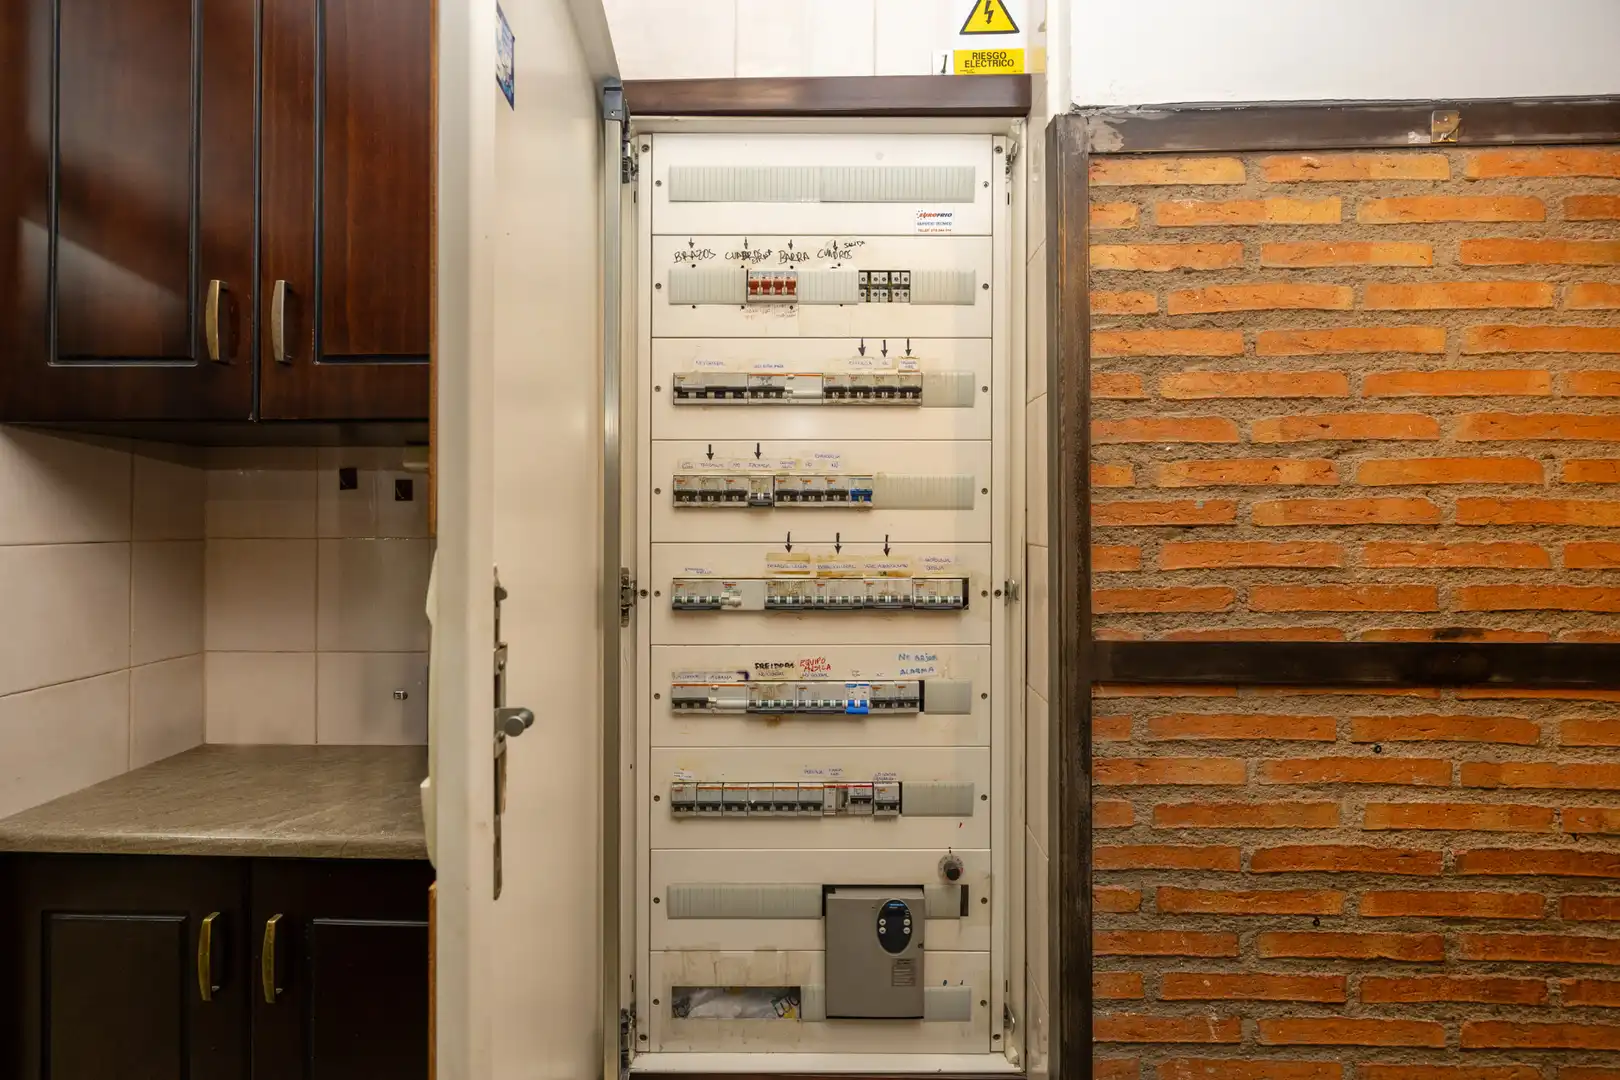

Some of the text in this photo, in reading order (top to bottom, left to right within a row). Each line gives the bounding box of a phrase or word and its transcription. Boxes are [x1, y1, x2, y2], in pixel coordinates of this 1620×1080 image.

[972, 52, 1007, 60] RIESGO
[964, 59, 1015, 68] ELECTRICO
[778, 249, 810, 264] BARRA
